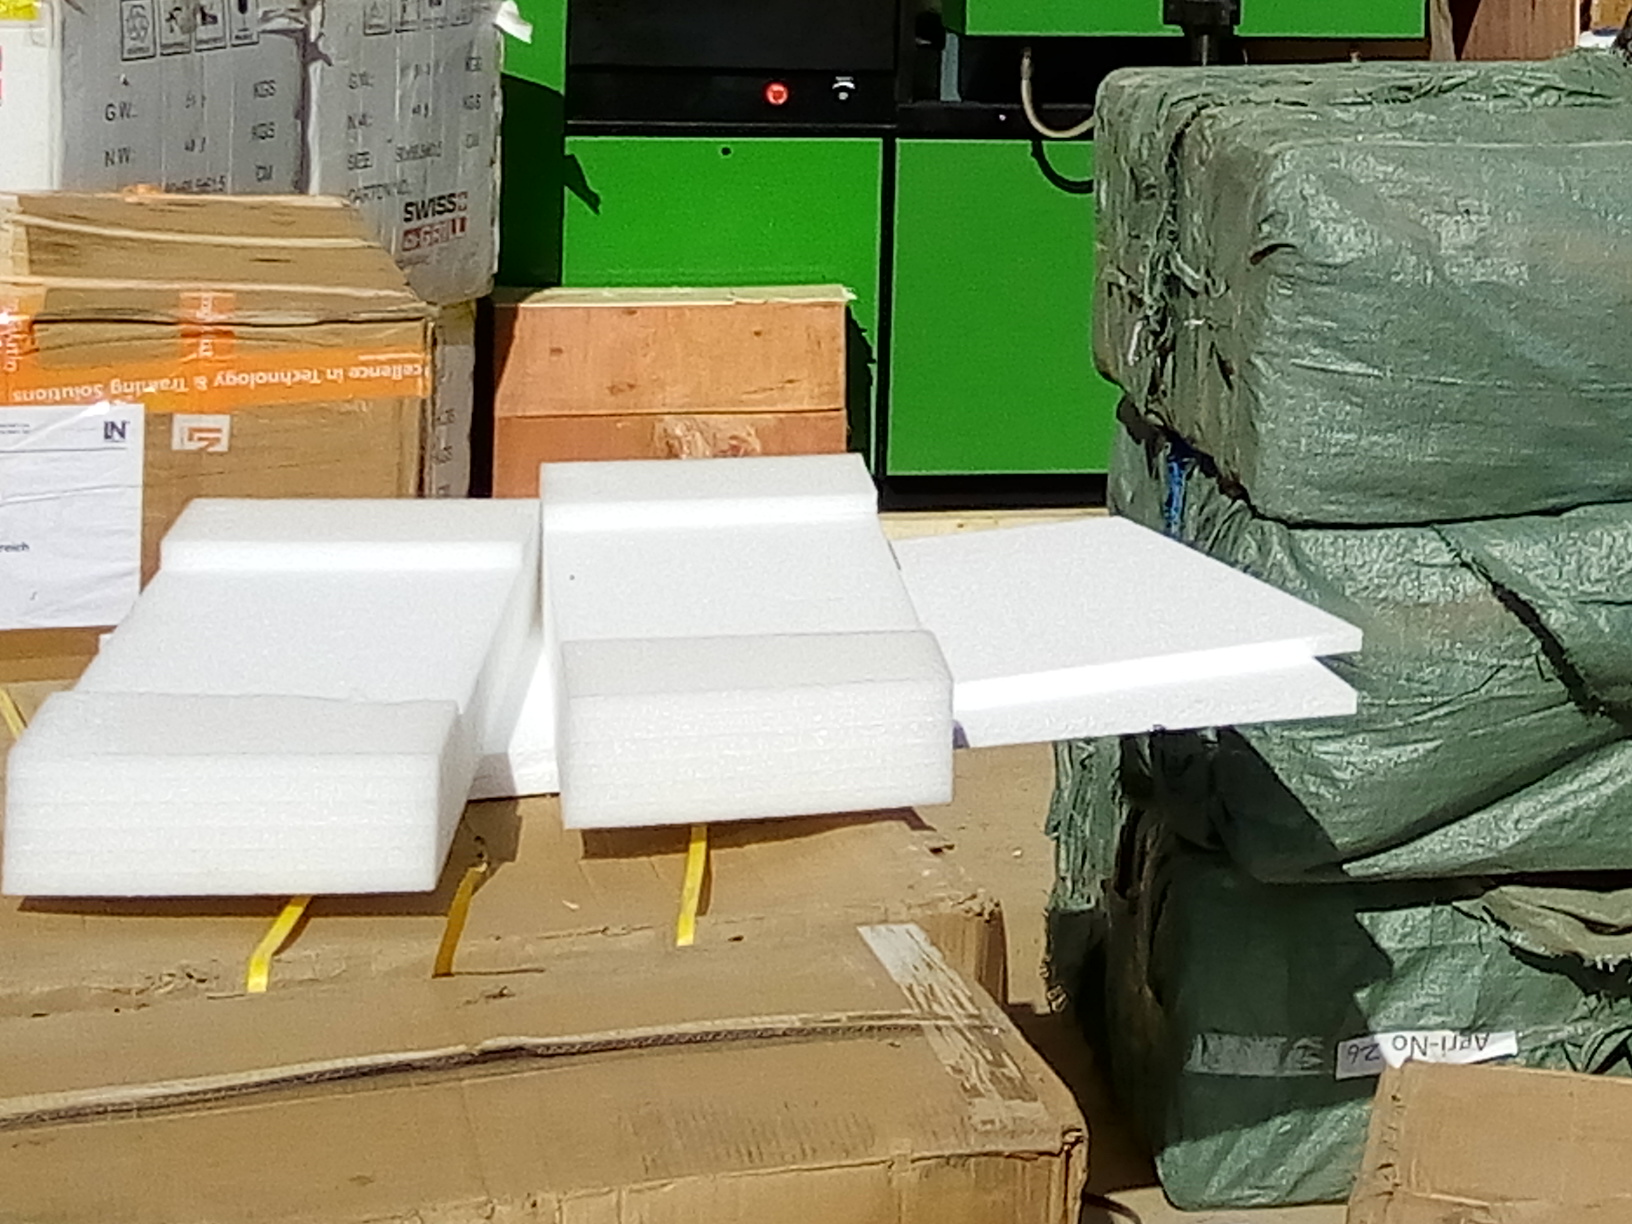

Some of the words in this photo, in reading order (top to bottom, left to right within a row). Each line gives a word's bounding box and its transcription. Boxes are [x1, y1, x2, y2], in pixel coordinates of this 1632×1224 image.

[403, 192, 457, 223] SWISS
[194, 376, 208, 391] &
[213, 369, 323, 390] Technology
[326, 368, 345, 383] in
[13, 383, 104, 402] Solutions
